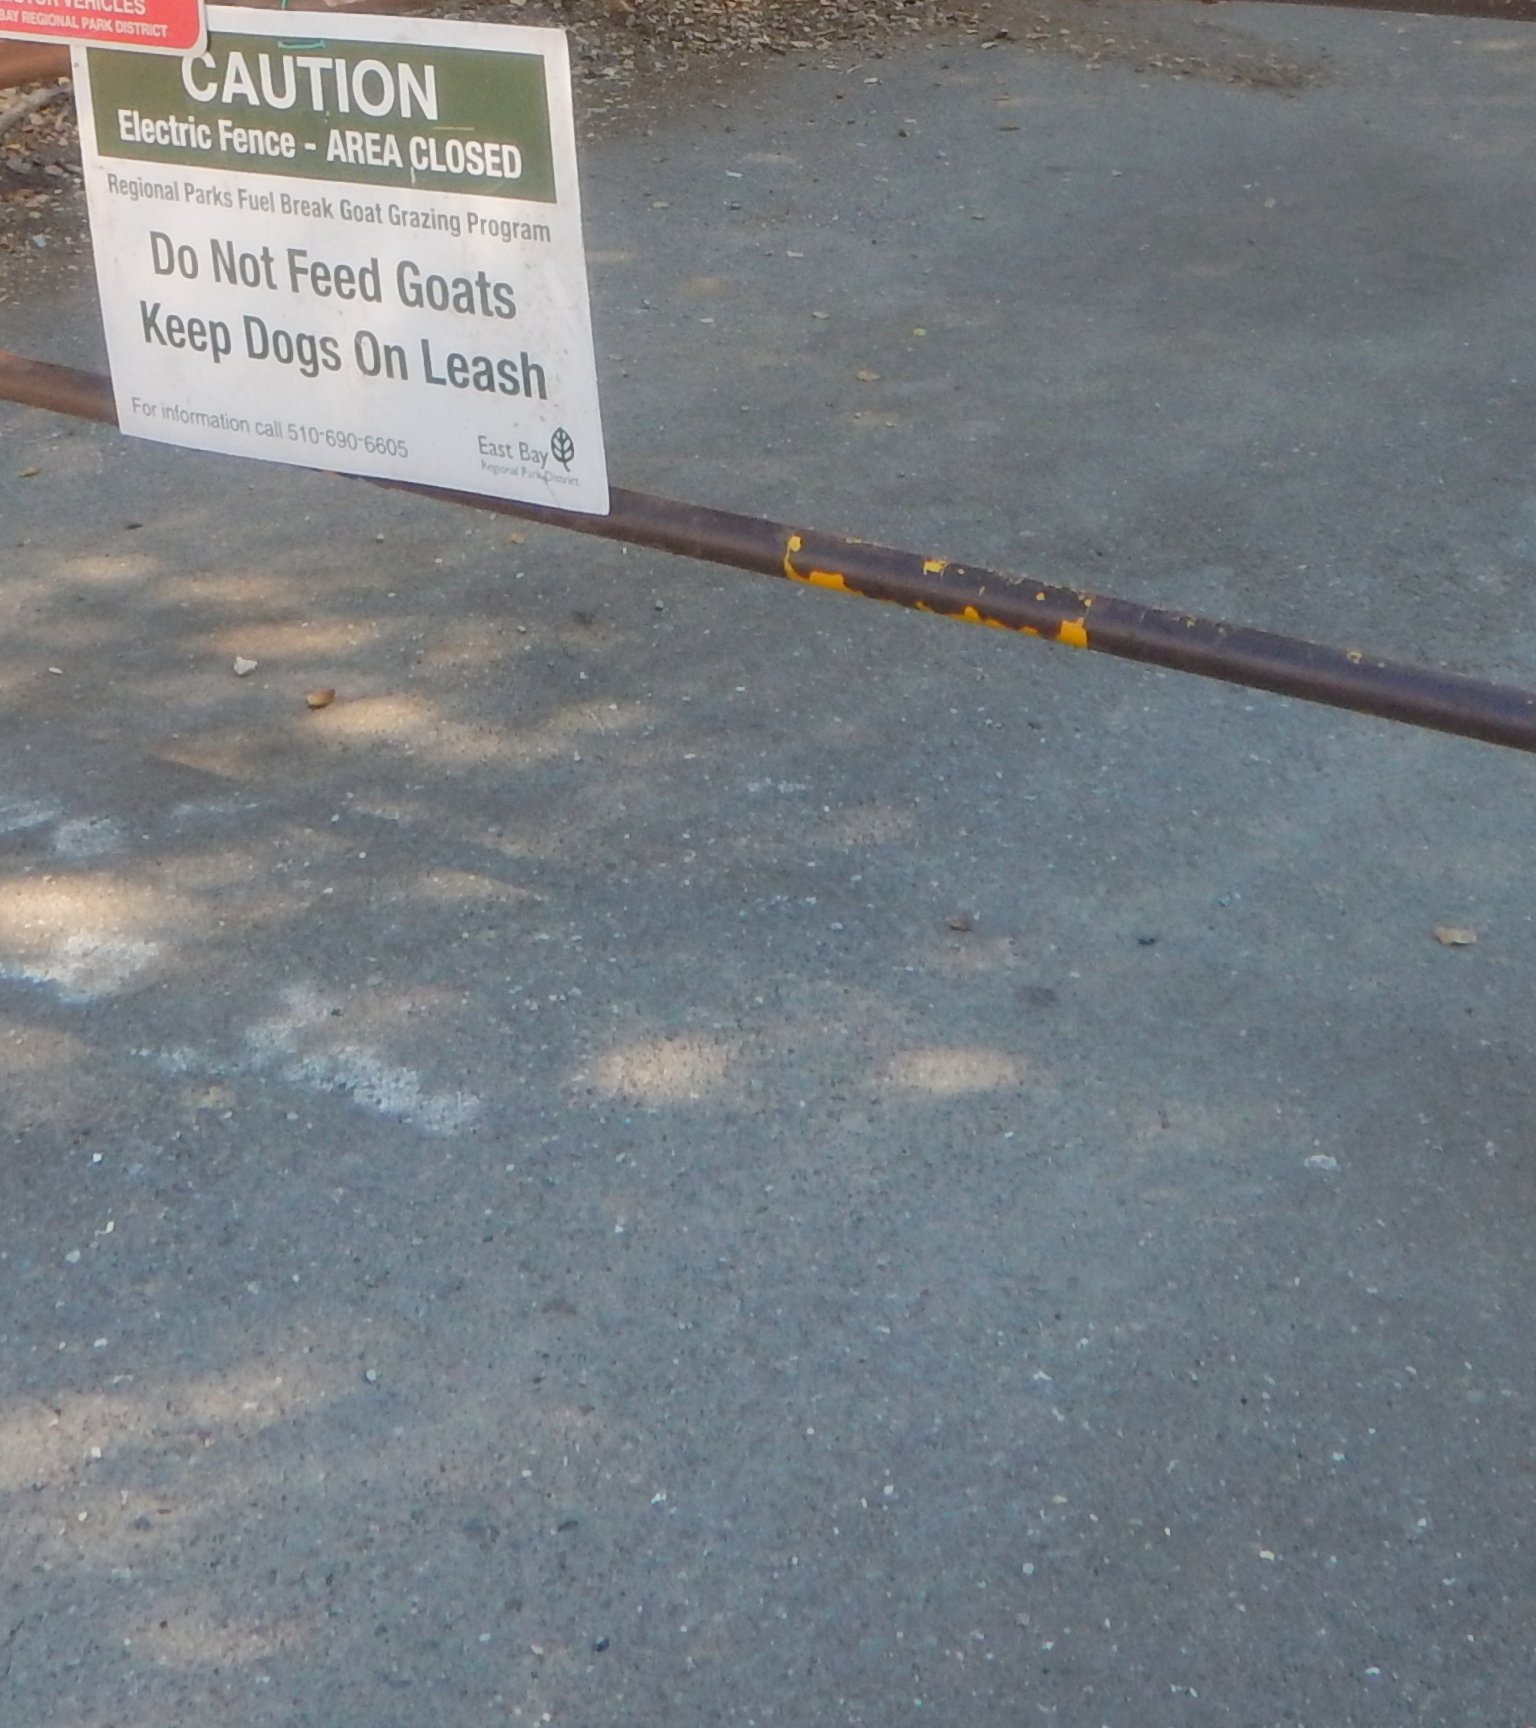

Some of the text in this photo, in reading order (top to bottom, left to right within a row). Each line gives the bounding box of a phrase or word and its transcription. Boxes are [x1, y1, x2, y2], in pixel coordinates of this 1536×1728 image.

[22, 11, 78, 28] REGIONAL
[82, 19, 113, 33] PARK
[116, 21, 168, 38] DISTRICT
[181, 50, 438, 120] CAUTION
[118, 109, 522, 179] Electric Fence - AREA CLOSED
[107, 173, 551, 243] Regional Parks Fuel Break Goat Grazing Program
[150, 230, 517, 320] Do Not Feed Goats
[139, 300, 548, 400] Keep Dogs On Leash
[132, 397, 409, 459] For information call 510-690-6605
[478, 435, 549, 470] East Bay
